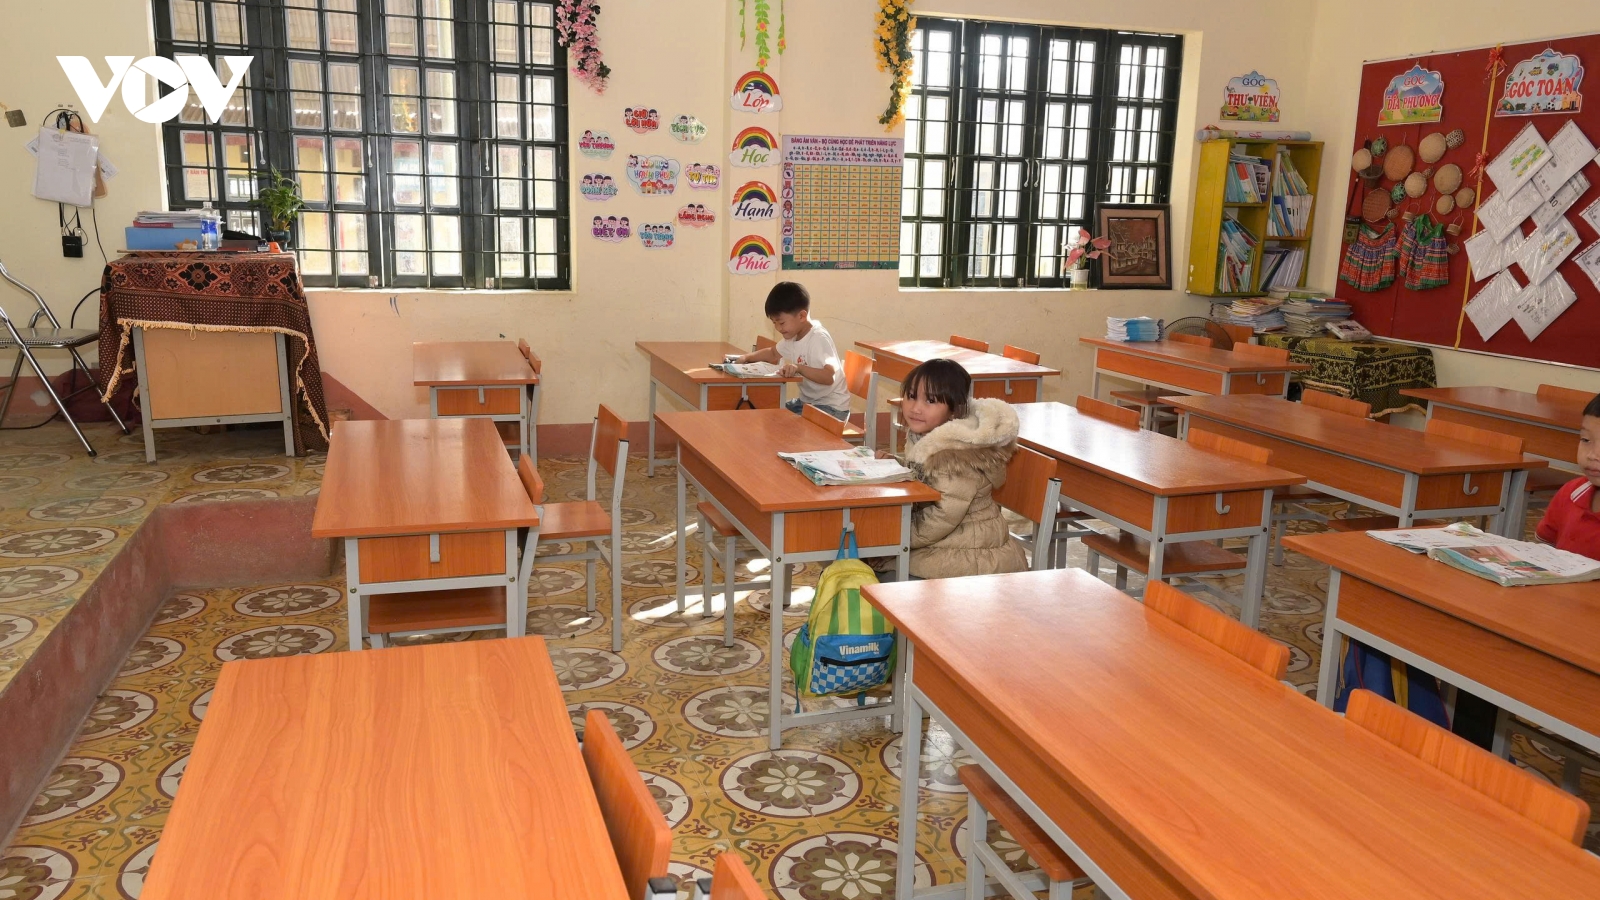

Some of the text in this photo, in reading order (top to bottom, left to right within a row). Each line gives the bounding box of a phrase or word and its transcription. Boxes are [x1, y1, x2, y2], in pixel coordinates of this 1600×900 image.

[1242, 76, 1265, 87] GÓC
[1508, 73, 1576, 98] GÓC TOÁN
[743, 93, 770, 112] Lớp
[1228, 93, 1249, 107] THƯ
[741, 148, 769, 166] Học
[735, 202, 774, 220] Hạnh
[735, 256, 771, 271] Phúc
[839, 642, 879, 655] Vinamilk
